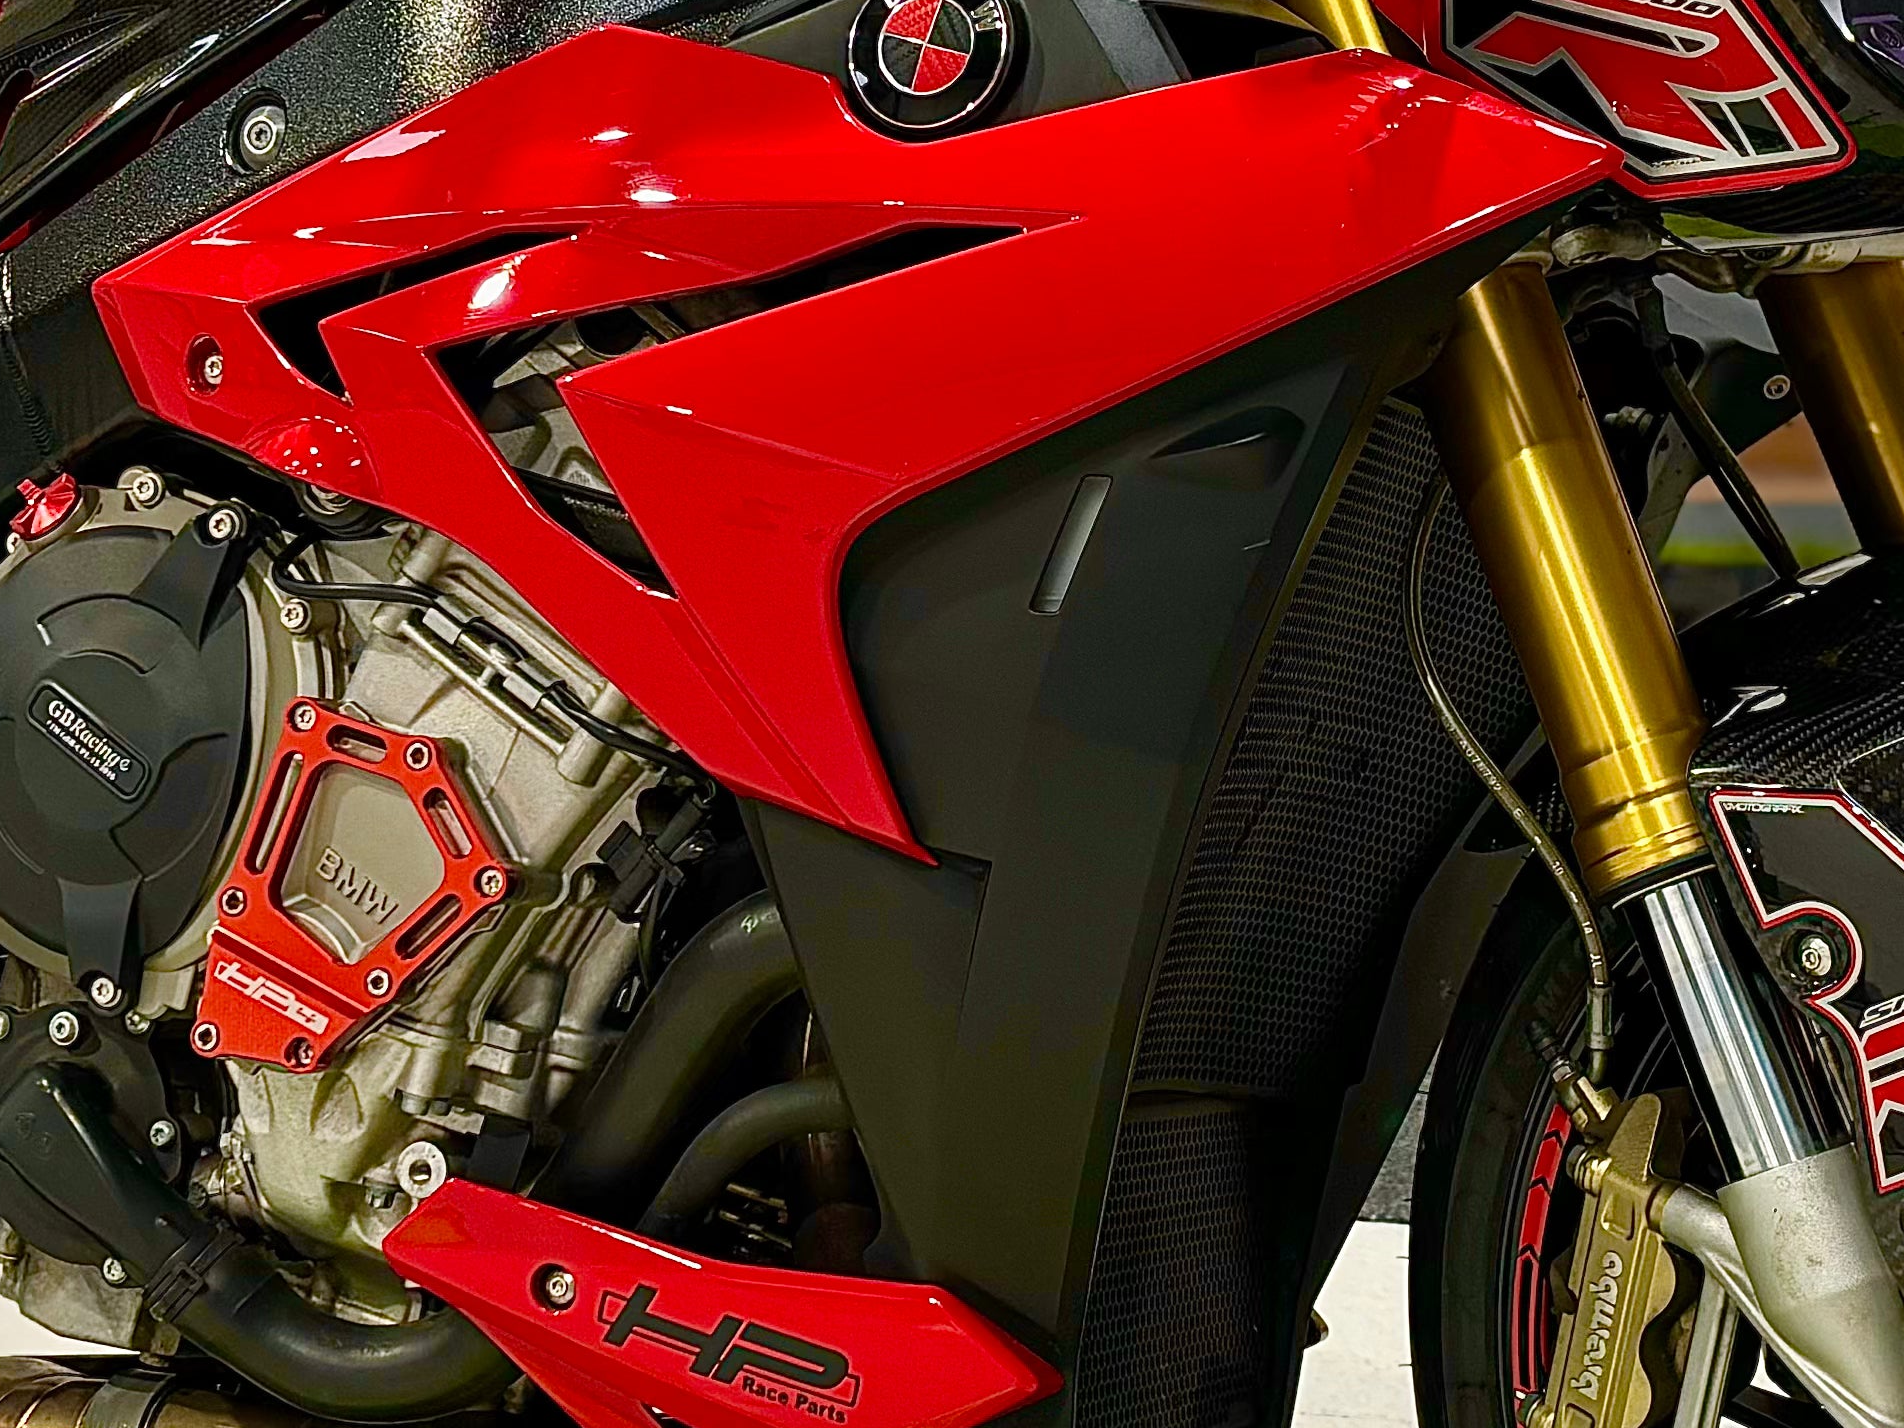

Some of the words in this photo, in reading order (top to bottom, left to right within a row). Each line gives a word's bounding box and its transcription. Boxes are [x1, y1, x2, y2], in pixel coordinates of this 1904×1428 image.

[315, 847, 398, 924] BMW
[602, 1283, 850, 1389] HP
[1569, 1249, 1624, 1400] brembo
[741, 1375, 789, 1407] Race
[794, 1389, 848, 1425] Parts
